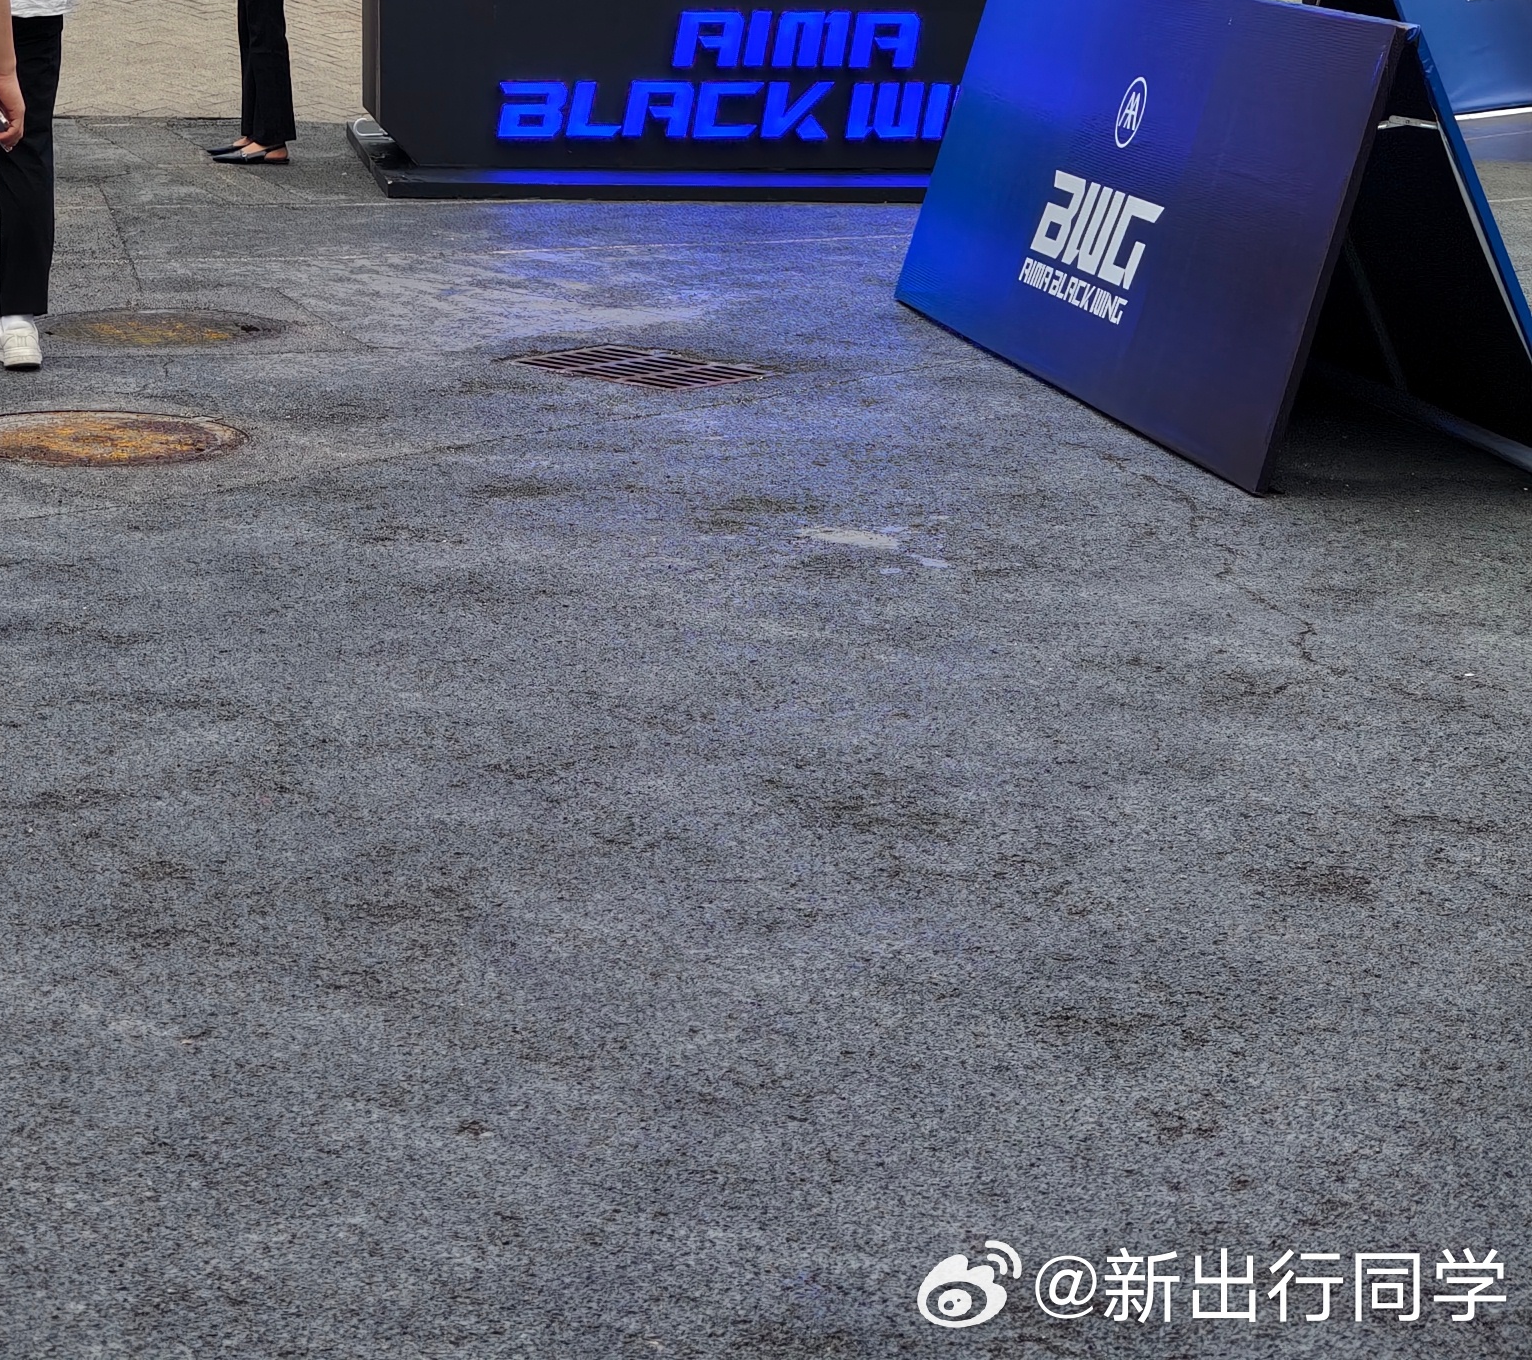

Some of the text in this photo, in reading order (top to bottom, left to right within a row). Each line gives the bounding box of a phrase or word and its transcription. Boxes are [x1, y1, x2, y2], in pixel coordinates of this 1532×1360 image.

[671, 8, 922, 69] AIMA
[496, 80, 959, 141] BLACK WI
[1018, 256, 1128, 325] AIMA BLACK WING
